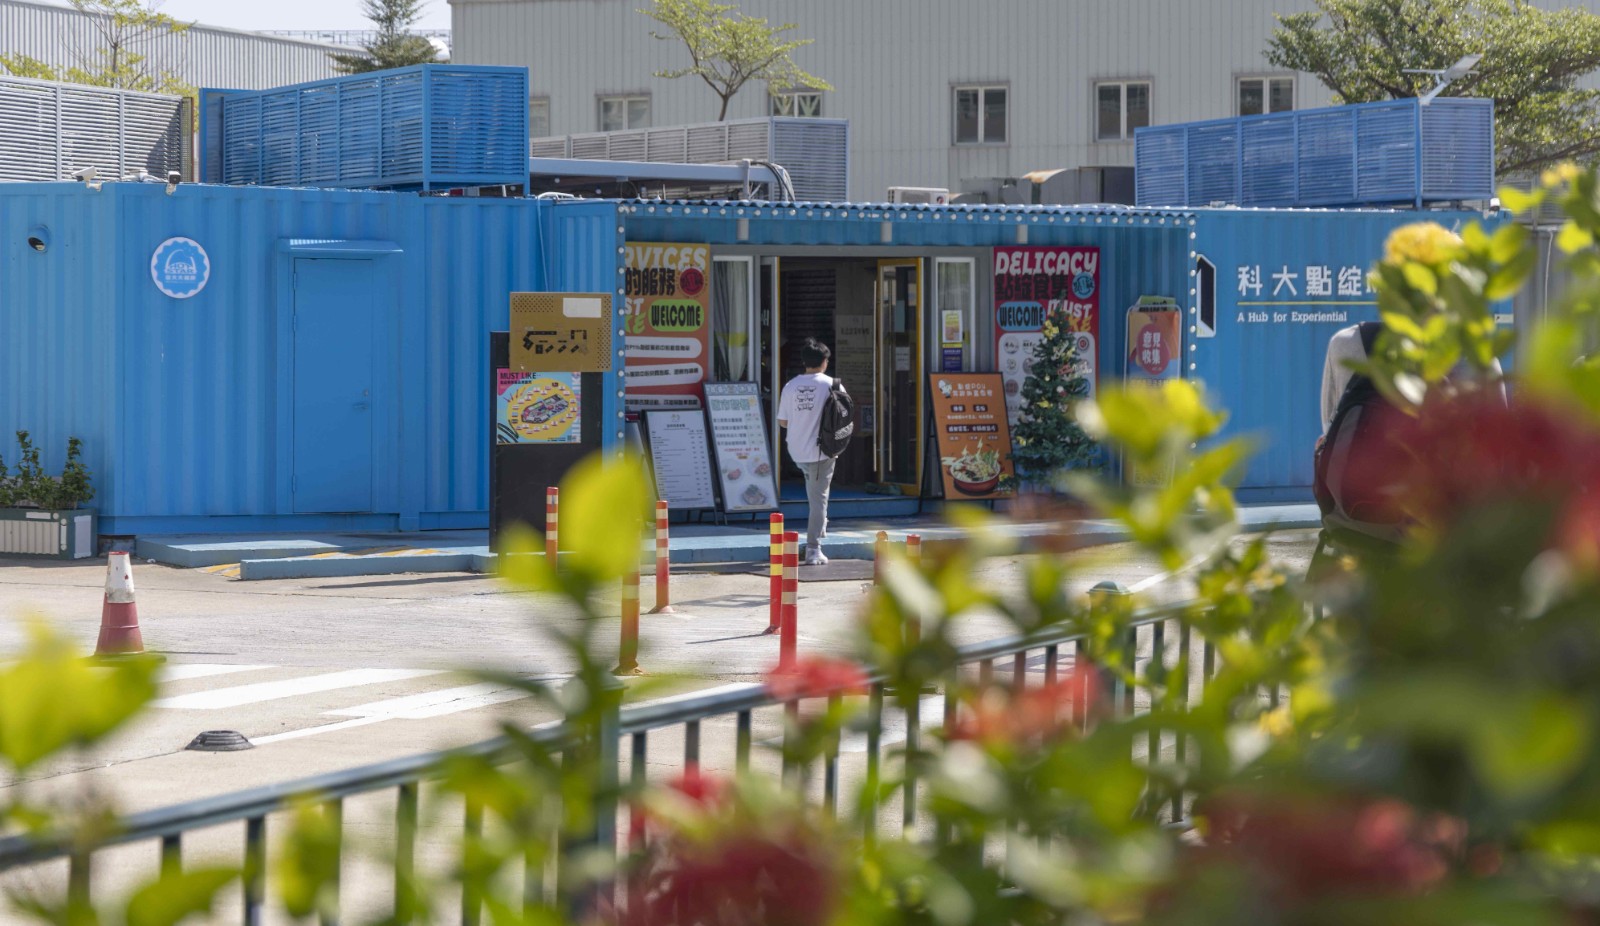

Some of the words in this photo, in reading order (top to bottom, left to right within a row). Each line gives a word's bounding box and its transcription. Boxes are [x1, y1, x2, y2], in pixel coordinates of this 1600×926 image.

[995, 251, 1098, 275] DELICACY
[1238, 265, 1362, 297] 科大點綻
[651, 304, 701, 327] WELCOME
[1000, 306, 1043, 327] WELCOME
[1237, 312, 1245, 322] A
[1248, 312, 1268, 322] Hub
[1273, 312, 1287, 322] for
[1291, 311, 1347, 323] Experiential
[1142, 331, 1161, 348] 意見
[1142, 349, 1161, 365] 收集
